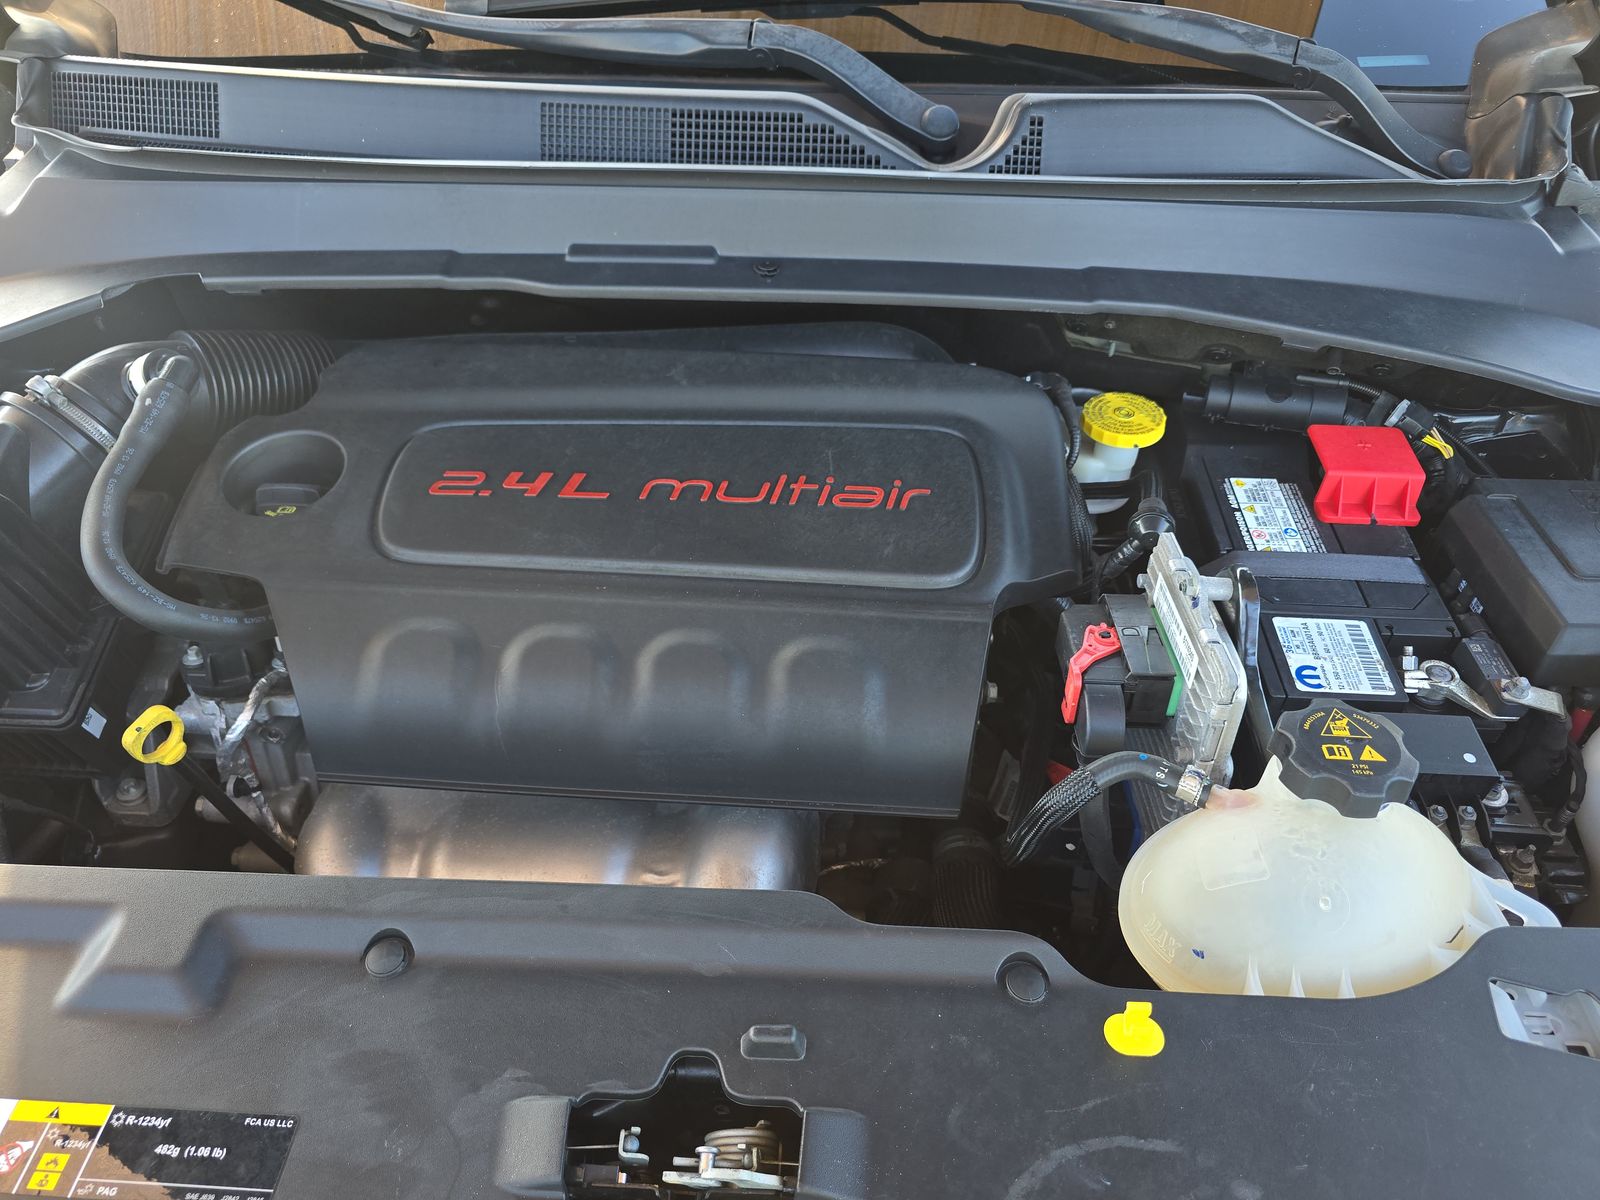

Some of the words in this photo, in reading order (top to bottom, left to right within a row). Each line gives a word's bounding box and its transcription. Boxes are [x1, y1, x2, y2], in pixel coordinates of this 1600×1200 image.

[638, 473, 931, 510] multiair
[125, 1115, 172, 1129] R-1234yf
[244, 1118, 261, 1126] FCA
[263, 1119, 275, 1127] US
[277, 1119, 294, 1128] LLC
[96, 1186, 118, 1196] PAG
